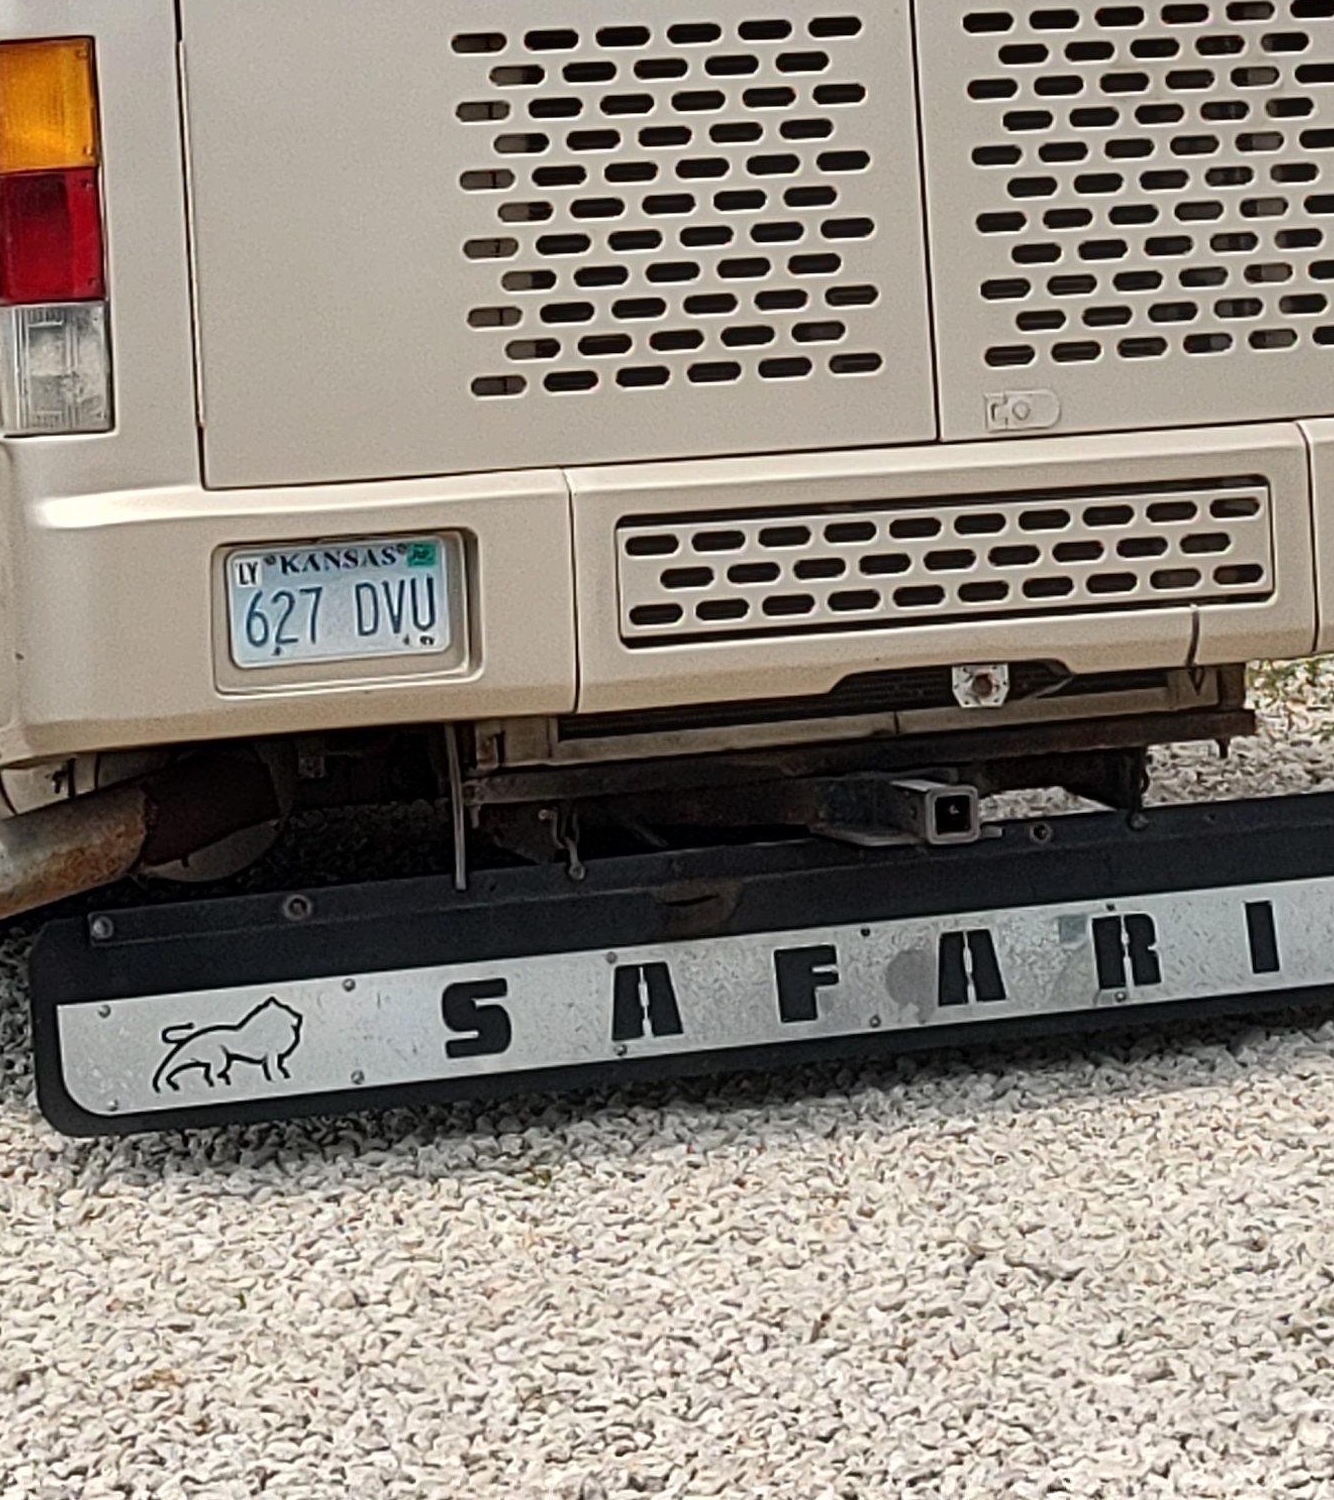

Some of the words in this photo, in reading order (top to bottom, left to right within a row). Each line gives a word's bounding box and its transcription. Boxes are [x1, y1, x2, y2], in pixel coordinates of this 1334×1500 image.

[237, 562, 259, 585] LY
[280, 545, 398, 575] KANSAS
[245, 586, 323, 647] 627
[354, 574, 437, 637] DVU
[441, 900, 1279, 1059] SAFARI
